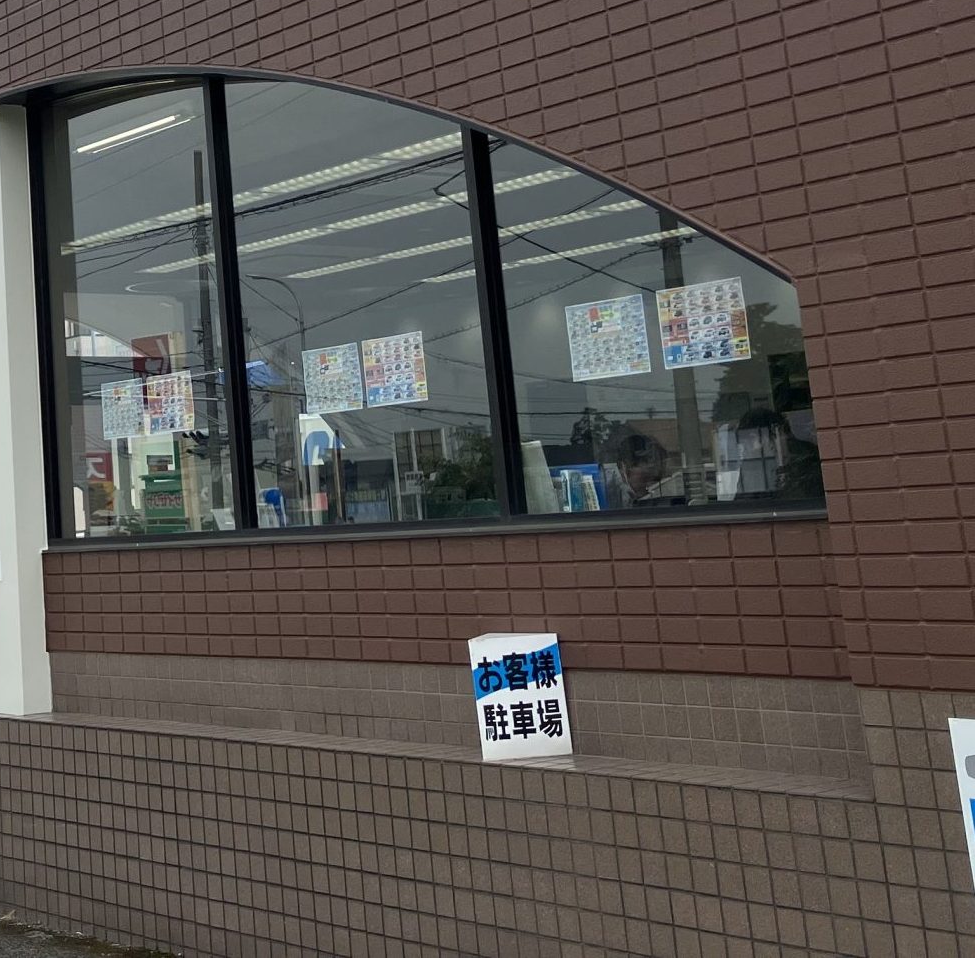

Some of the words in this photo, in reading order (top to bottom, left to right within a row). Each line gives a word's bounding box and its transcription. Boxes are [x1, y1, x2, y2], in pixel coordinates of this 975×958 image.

[477, 650, 558, 693] お客様
[483, 698, 564, 742] 駐車場
